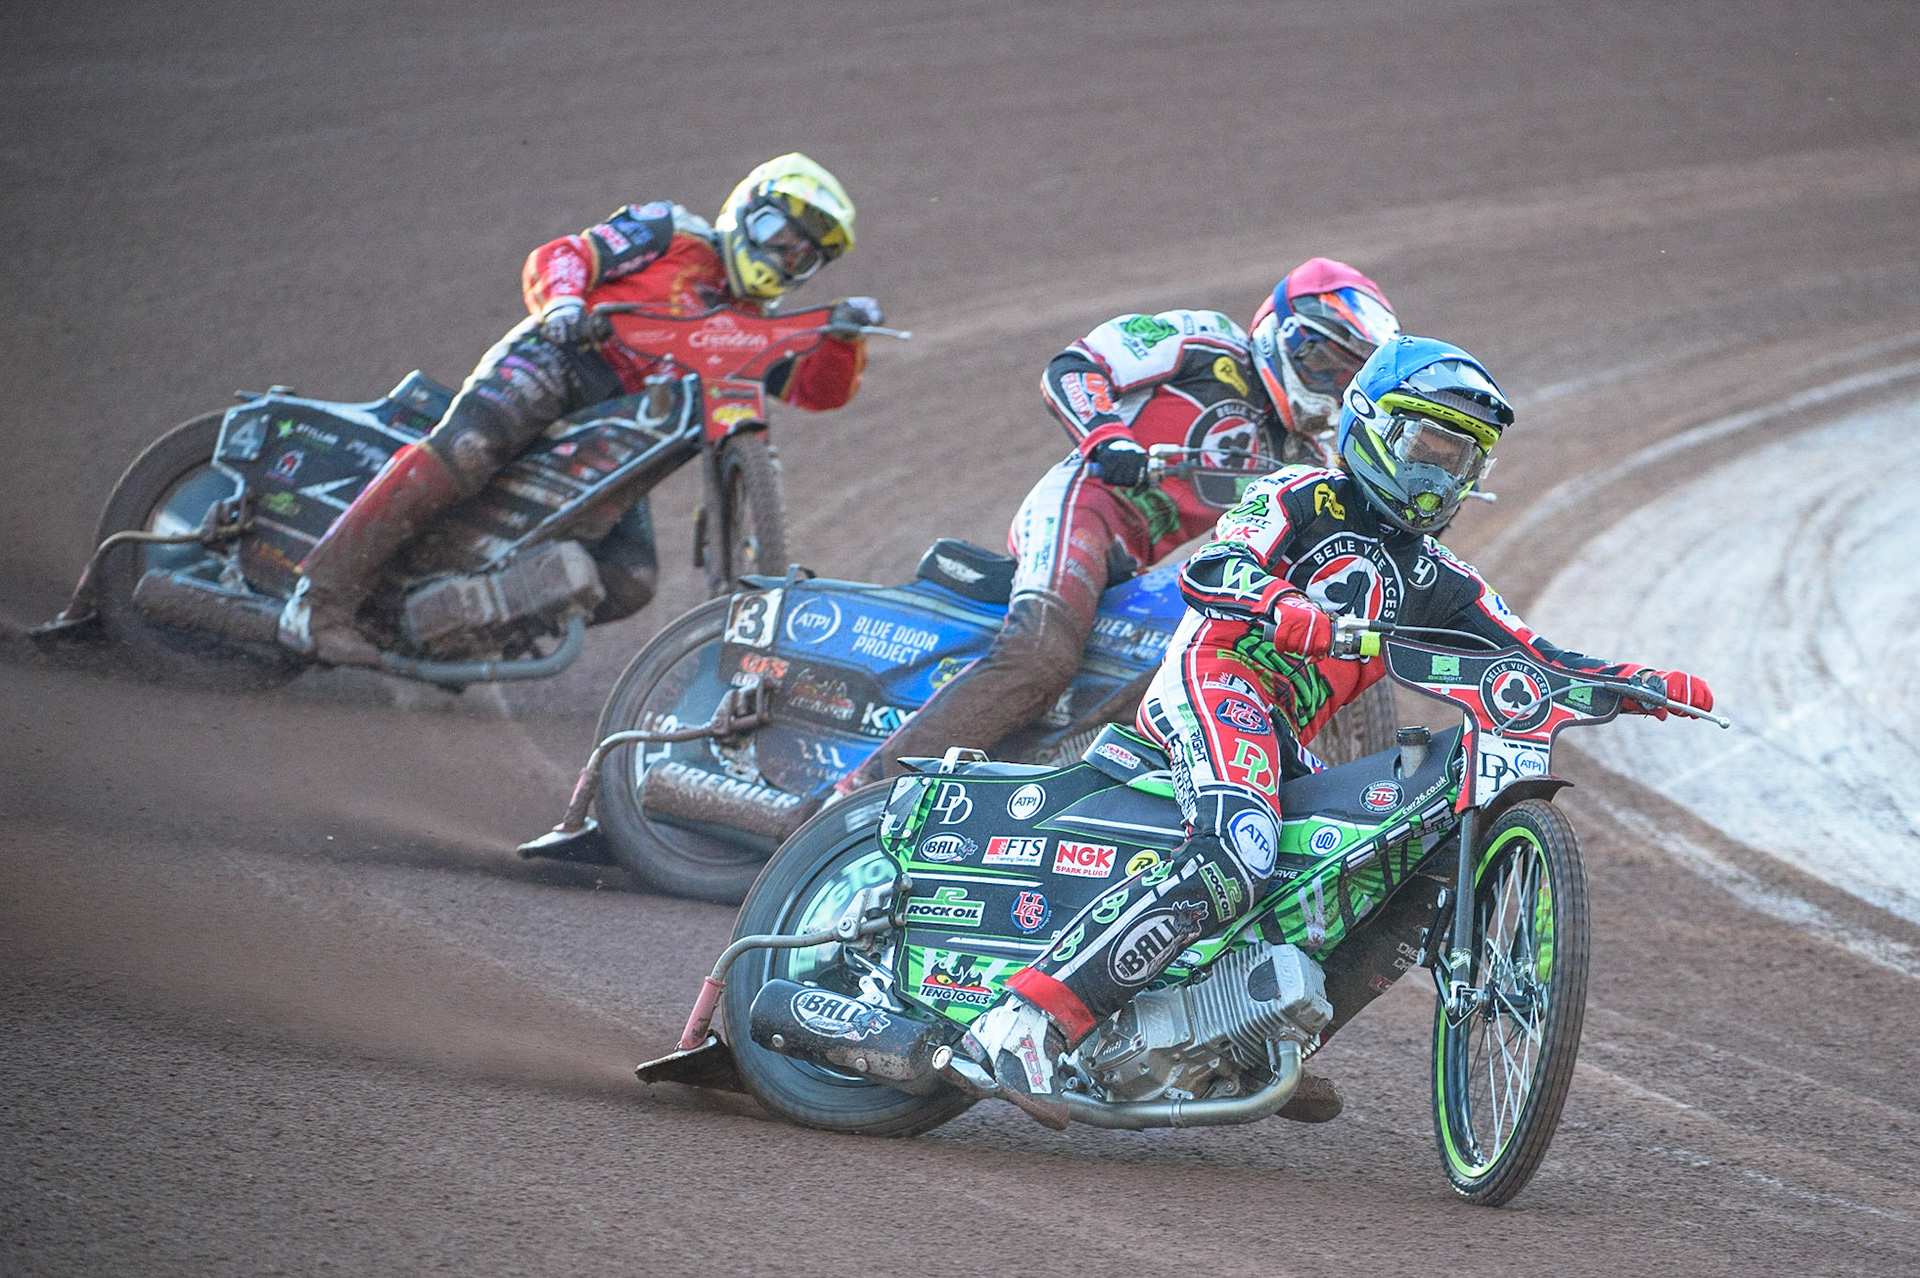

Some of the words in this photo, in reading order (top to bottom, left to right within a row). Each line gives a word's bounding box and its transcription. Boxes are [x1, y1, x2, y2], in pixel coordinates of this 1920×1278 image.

[229, 420, 257, 456] 4
[1363, 543, 1386, 571] VUE
[1384, 577, 1397, 619] ACES
[1413, 559, 1432, 584] 4
[738, 595, 768, 640] 3
[795, 612, 832, 630] ATPI
[853, 616, 894, 638] BLUE
[892, 624, 939, 651] DOOR
[852, 635, 921, 666] PROJECT
[1485, 663, 1508, 684] BELLE
[1511, 663, 1529, 672] VUE
[1531, 672, 1548, 694] ACES
[1520, 759, 1541, 771] ATPI
[661, 761, 800, 808] PREMIER
[1368, 790, 1396, 802] STS
[1402, 776, 1446, 815] cwr26.co.uk
[1014, 796, 1037, 806] ATPI
[1005, 839, 1043, 856] FTS
[1057, 844, 1114, 868] NGK
[1240, 823, 1270, 860] ATPI
[1056, 866, 1082, 874] SPARK
[1273, 869, 1298, 879] AVE
[1204, 867, 1227, 900] ROCK
[1220, 901, 1232, 920] OIL
[907, 905, 952, 915] ROCK
[953, 908, 978, 918] OIL
[1120, 917, 1181, 977] BALL
[803, 995, 861, 1022] BALL
